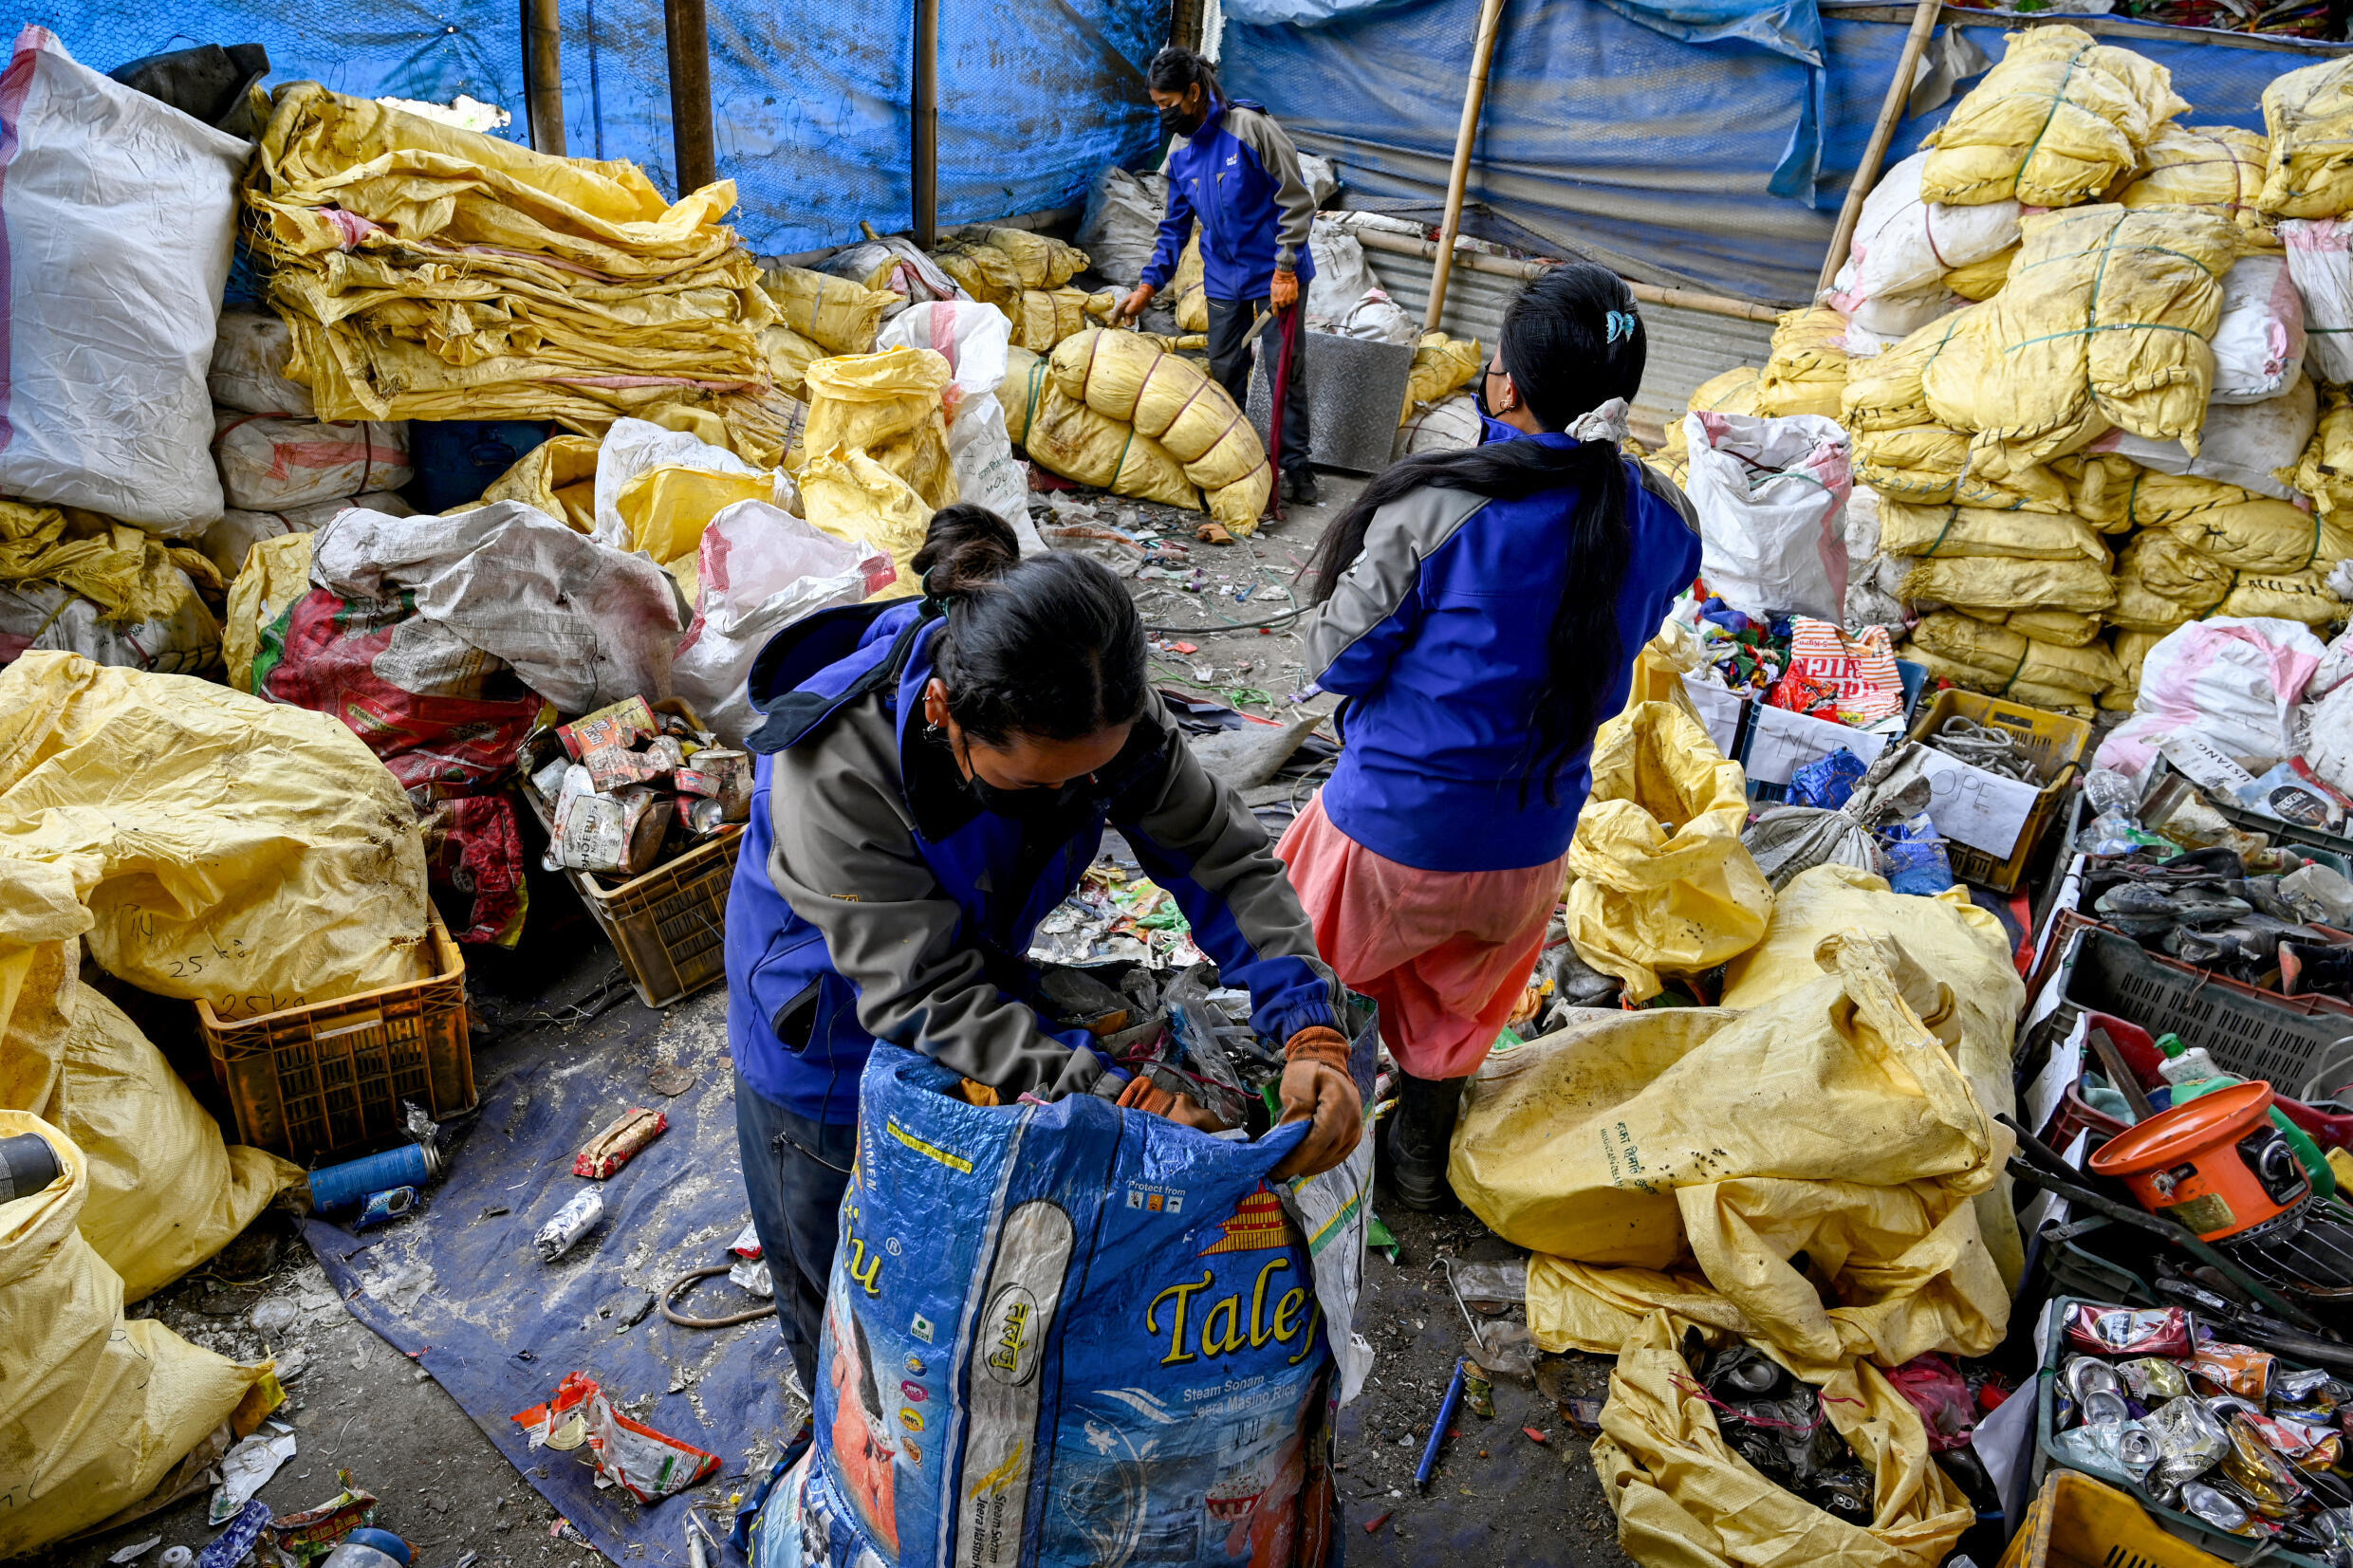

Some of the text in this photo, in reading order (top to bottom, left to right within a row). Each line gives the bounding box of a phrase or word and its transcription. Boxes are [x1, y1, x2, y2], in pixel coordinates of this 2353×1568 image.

[1128, 1180, 1186, 1196] Protect from
[1183, 1375, 1265, 1403] Steam Sonam
[1192, 1382, 1298, 1420] Jeera Masino Rice
[975, 1496, 989, 1525] Jeera
[972, 1526, 986, 1562] Masino
[989, 1494, 1007, 1564] Steam Sonam
